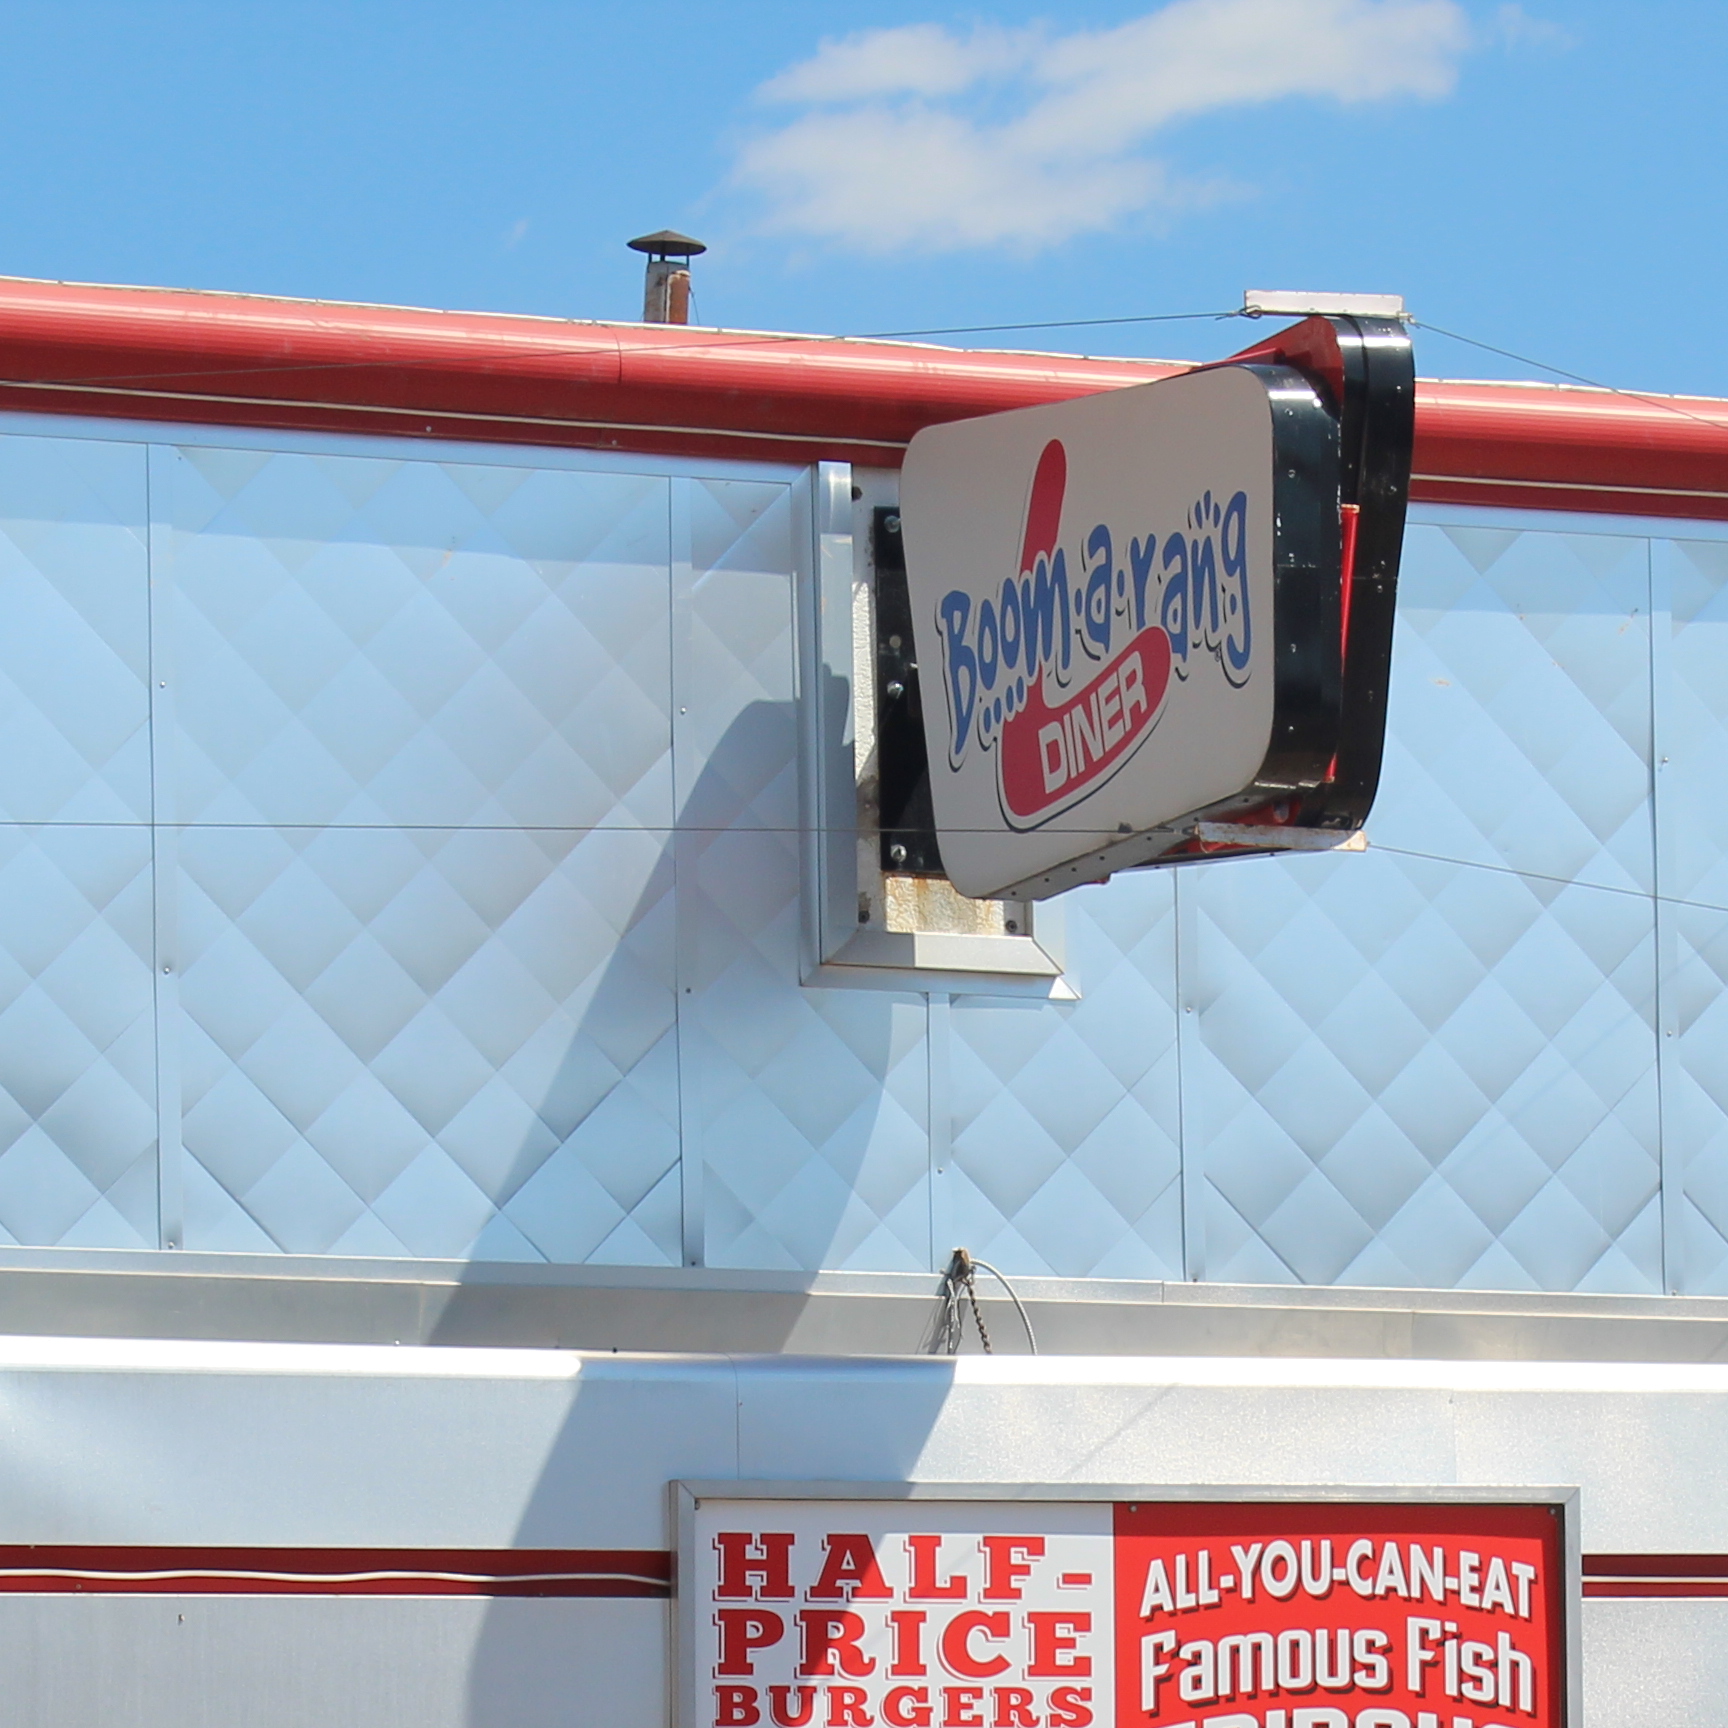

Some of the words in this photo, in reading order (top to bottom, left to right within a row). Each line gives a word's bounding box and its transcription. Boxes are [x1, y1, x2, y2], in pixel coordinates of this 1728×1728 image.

[1038, 650, 1148, 795] DINER
[712, 1532, 1093, 1603] HALF-
[1139, 1538, 1536, 1622] ALL-YOU-CAN-EAT
[712, 1608, 1093, 1682] PRICE
[1140, 1626, 1390, 1714] Famous
[1407, 1615, 1538, 1715] Fish
